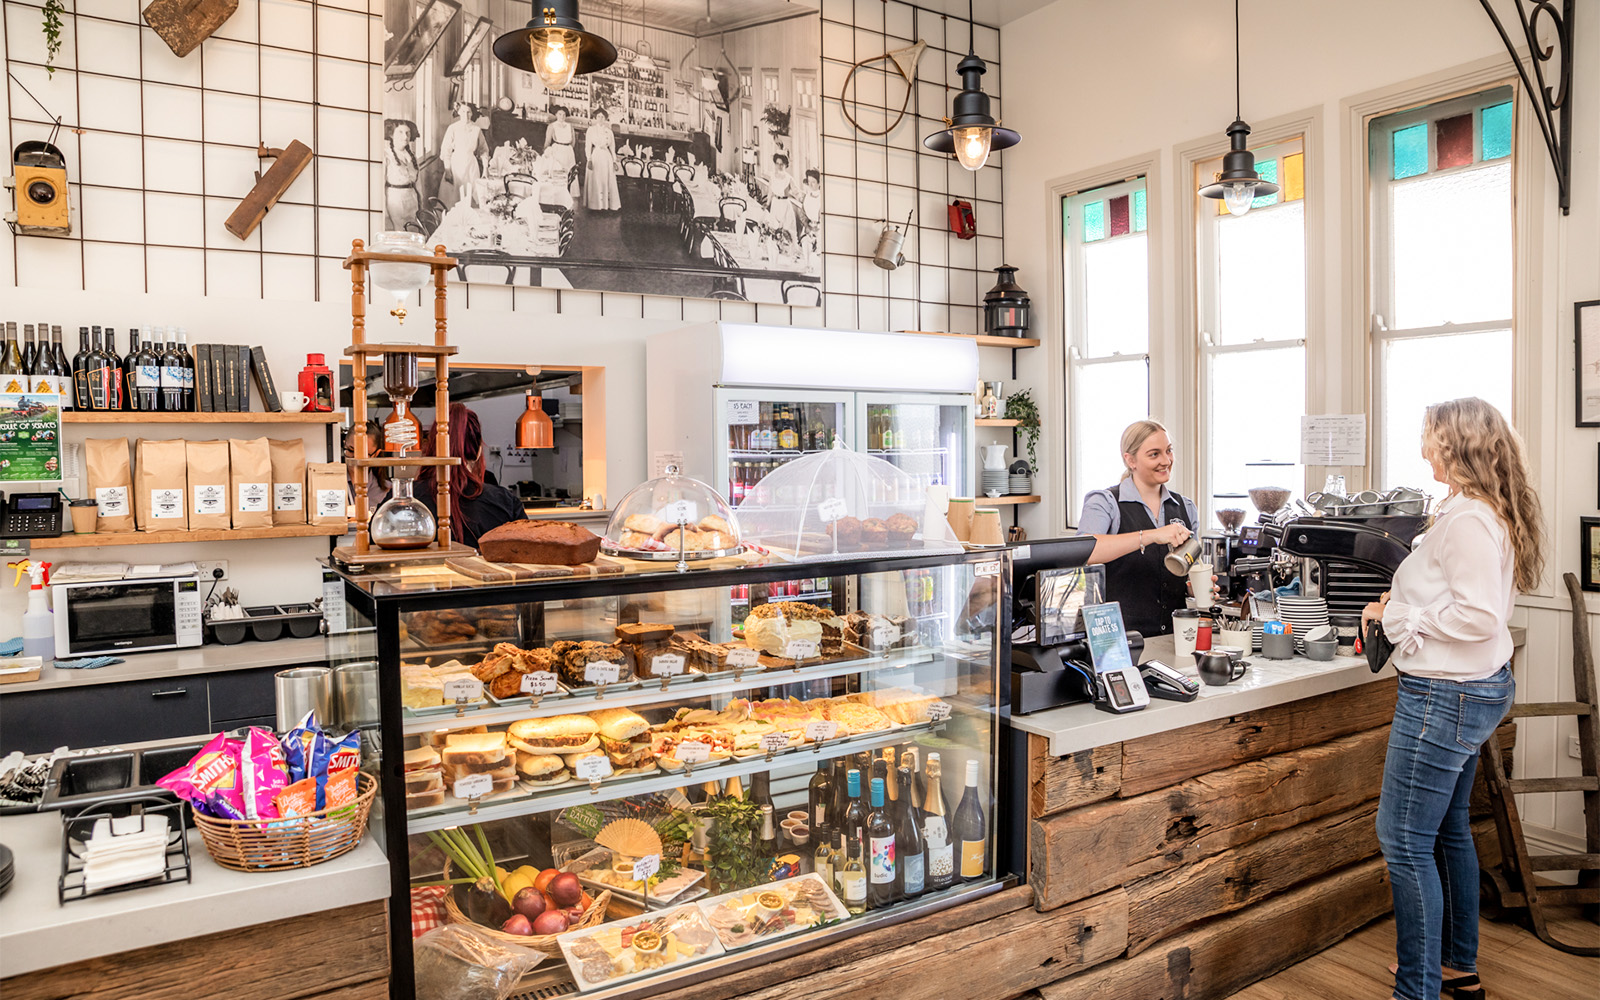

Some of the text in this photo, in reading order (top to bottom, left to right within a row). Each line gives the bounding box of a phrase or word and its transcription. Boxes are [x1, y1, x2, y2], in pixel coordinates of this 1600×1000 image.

[1091, 623, 1118, 636] DONATE $5
[1095, 616, 1112, 626] TAP TO
[191, 754, 234, 789] SMITHS
[569, 808, 599, 829] RATTLER
